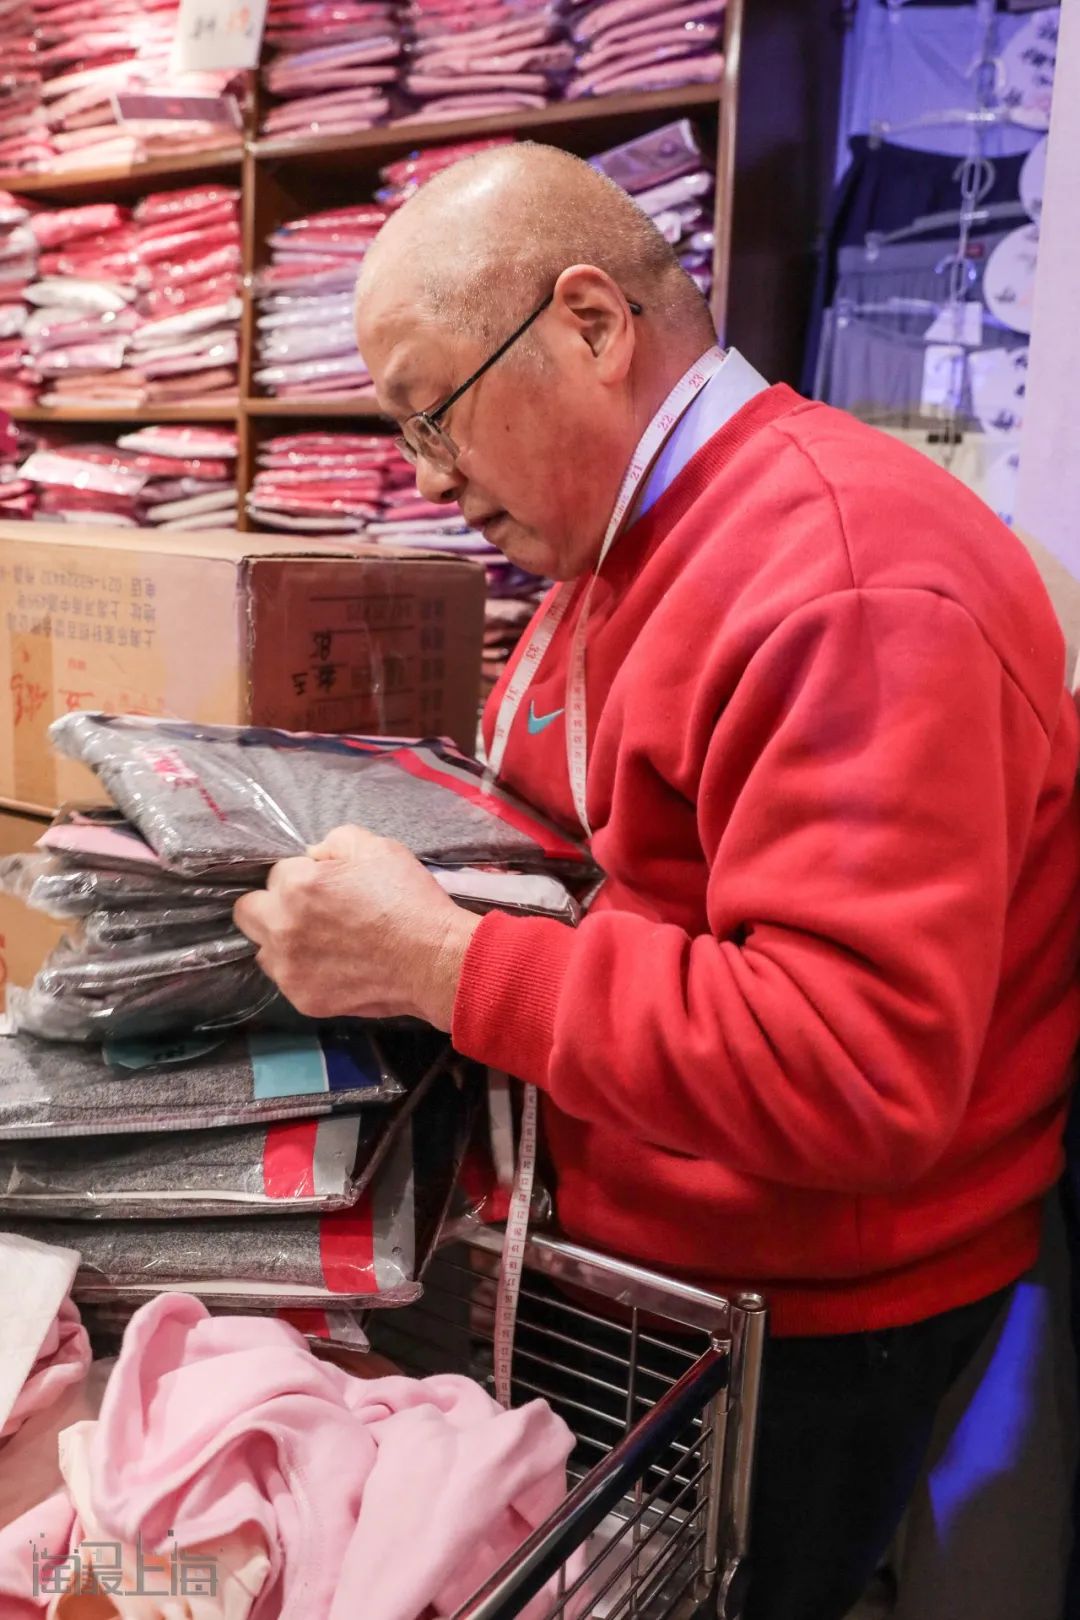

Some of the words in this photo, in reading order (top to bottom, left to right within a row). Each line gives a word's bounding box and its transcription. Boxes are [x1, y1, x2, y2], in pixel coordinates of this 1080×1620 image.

[688, 374, 705, 389] 23
[656, 414, 676, 432] 22
[630, 464, 643, 481] 21
[526, 644, 540, 660] 33
